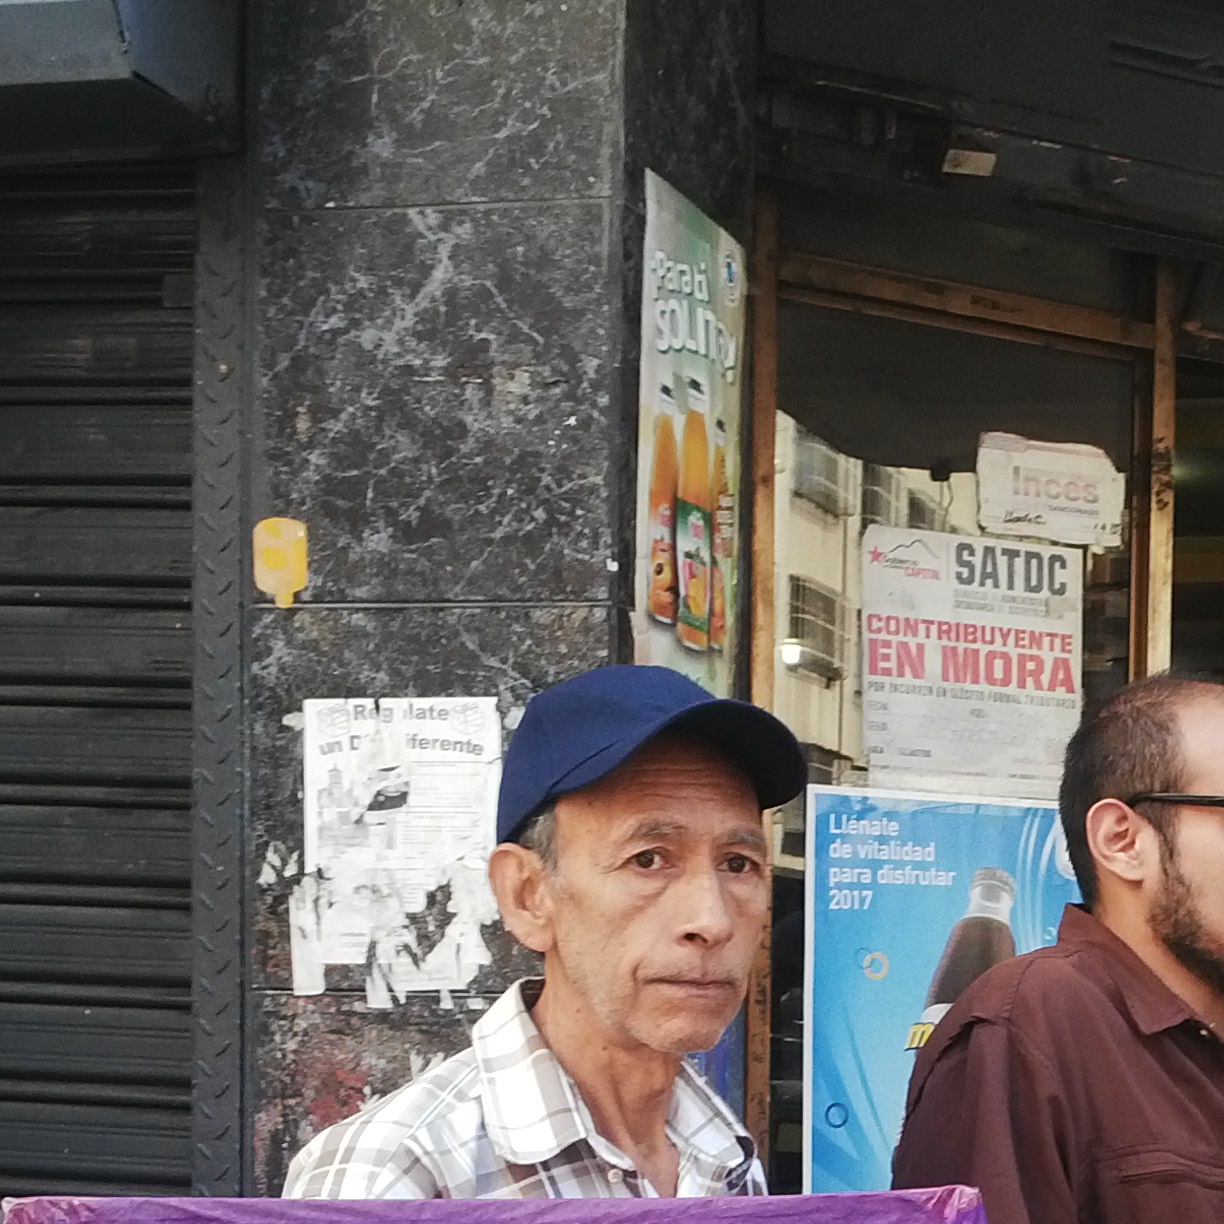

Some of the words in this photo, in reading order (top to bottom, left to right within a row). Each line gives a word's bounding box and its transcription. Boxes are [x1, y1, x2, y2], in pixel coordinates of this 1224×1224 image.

[1012, 465, 1100, 504] Inces
[955, 541, 1068, 597] SATDC
[866, 613, 1074, 654] CONTRIBUYENTE
[868, 637, 926, 681] EN
[941, 644, 1077, 695] MORA
[318, 740, 343, 756] un
[829, 813, 900, 837] Llénate
[829, 838, 853, 859] de
[857, 839, 937, 862] vitalidad
[829, 867, 872, 888] para
[877, 864, 957, 887] disfrutar
[828, 889, 874, 911] 2017
